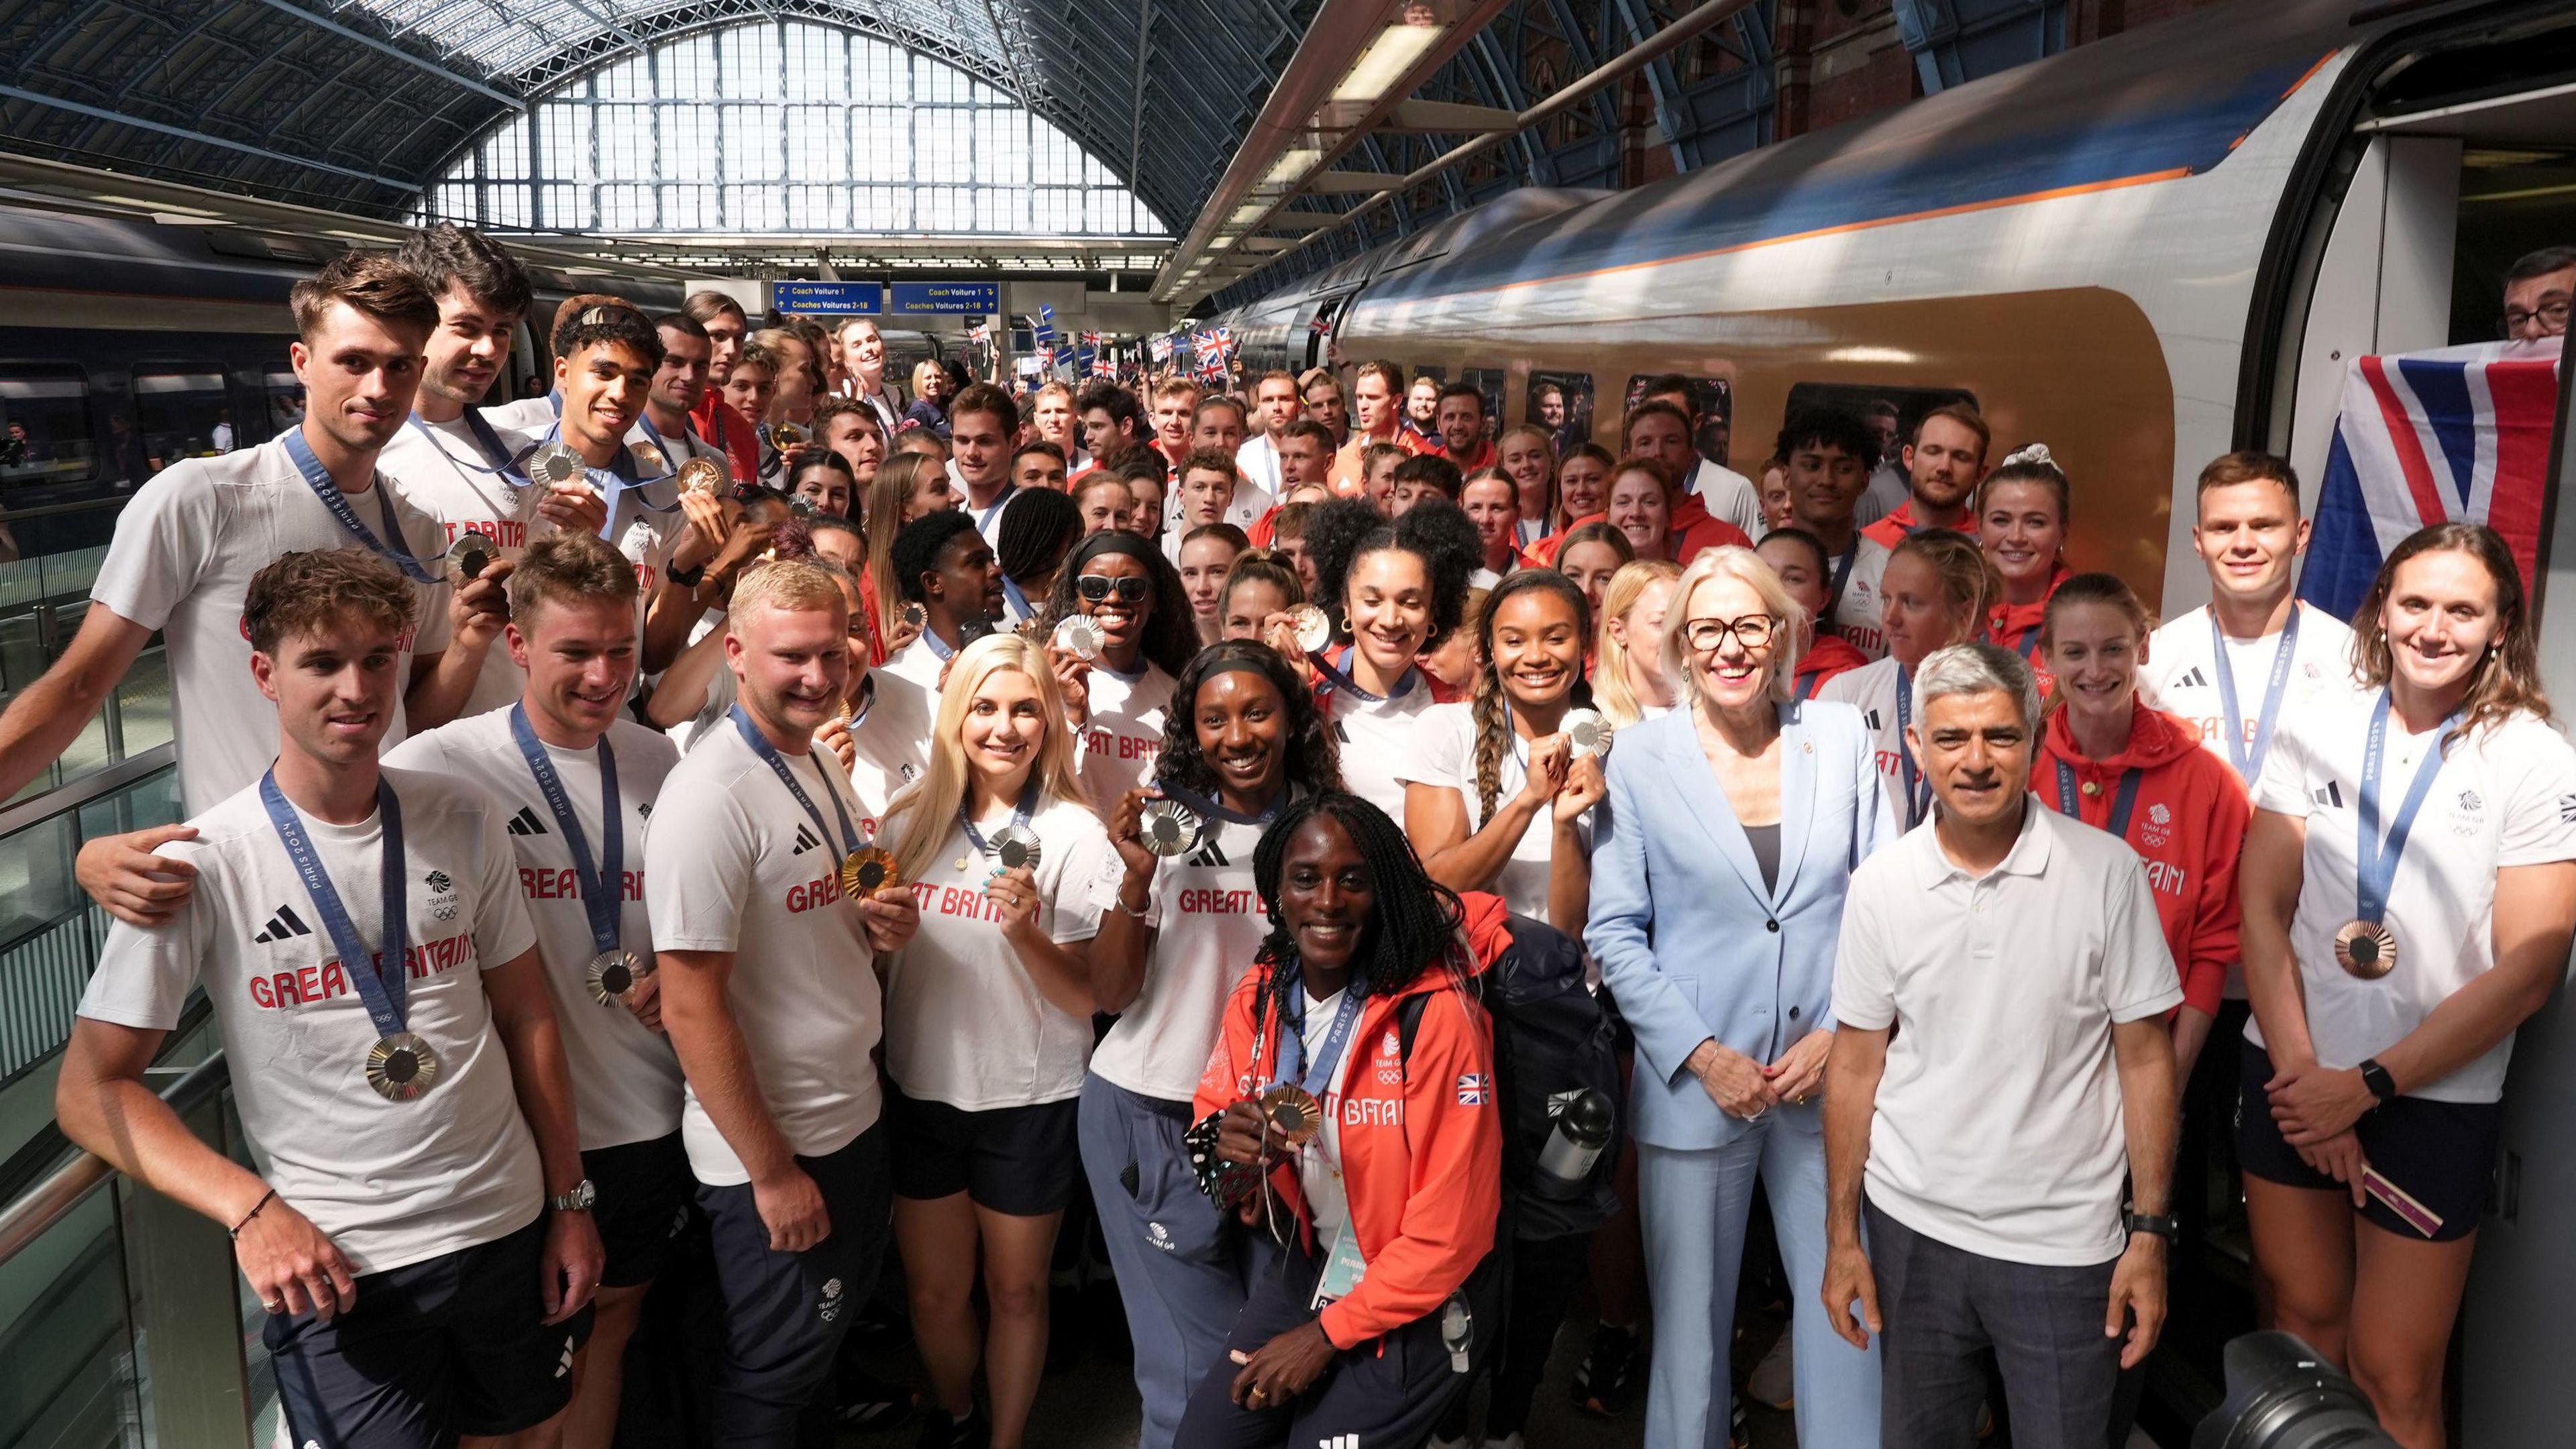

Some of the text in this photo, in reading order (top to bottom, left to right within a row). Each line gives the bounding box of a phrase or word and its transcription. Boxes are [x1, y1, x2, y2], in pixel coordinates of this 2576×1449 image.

[792, 301, 821, 309] Coaches
[822, 301, 851, 309] Voitures
[313, 475, 360, 529] PARIS 2024
[464, 521, 527, 548] RITAI
[1837, 624, 1883, 650] TAIN
[2281, 633, 2292, 659] 2024
[1120, 735, 1167, 760] BRIT
[2365, 721, 2380, 782] PARIS 2024
[533, 757, 568, 816] PARIS 2024
[2059, 764, 2068, 784] 202
[2141, 822, 2171, 837] TEAM GB
[282, 822, 322, 890] PARIS 2024
[519, 868, 584, 900] REA
[786, 869, 846, 914] GREA
[427, 896, 447, 906] TEAM
[1179, 888, 1252, 914] GREAT
[250, 953, 358, 1002] GREA
[1330, 1011, 1348, 1044] PARIS
[1375, 1058, 1401, 1068] TEAM G
[817, 1299, 837, 1309] TEAM
